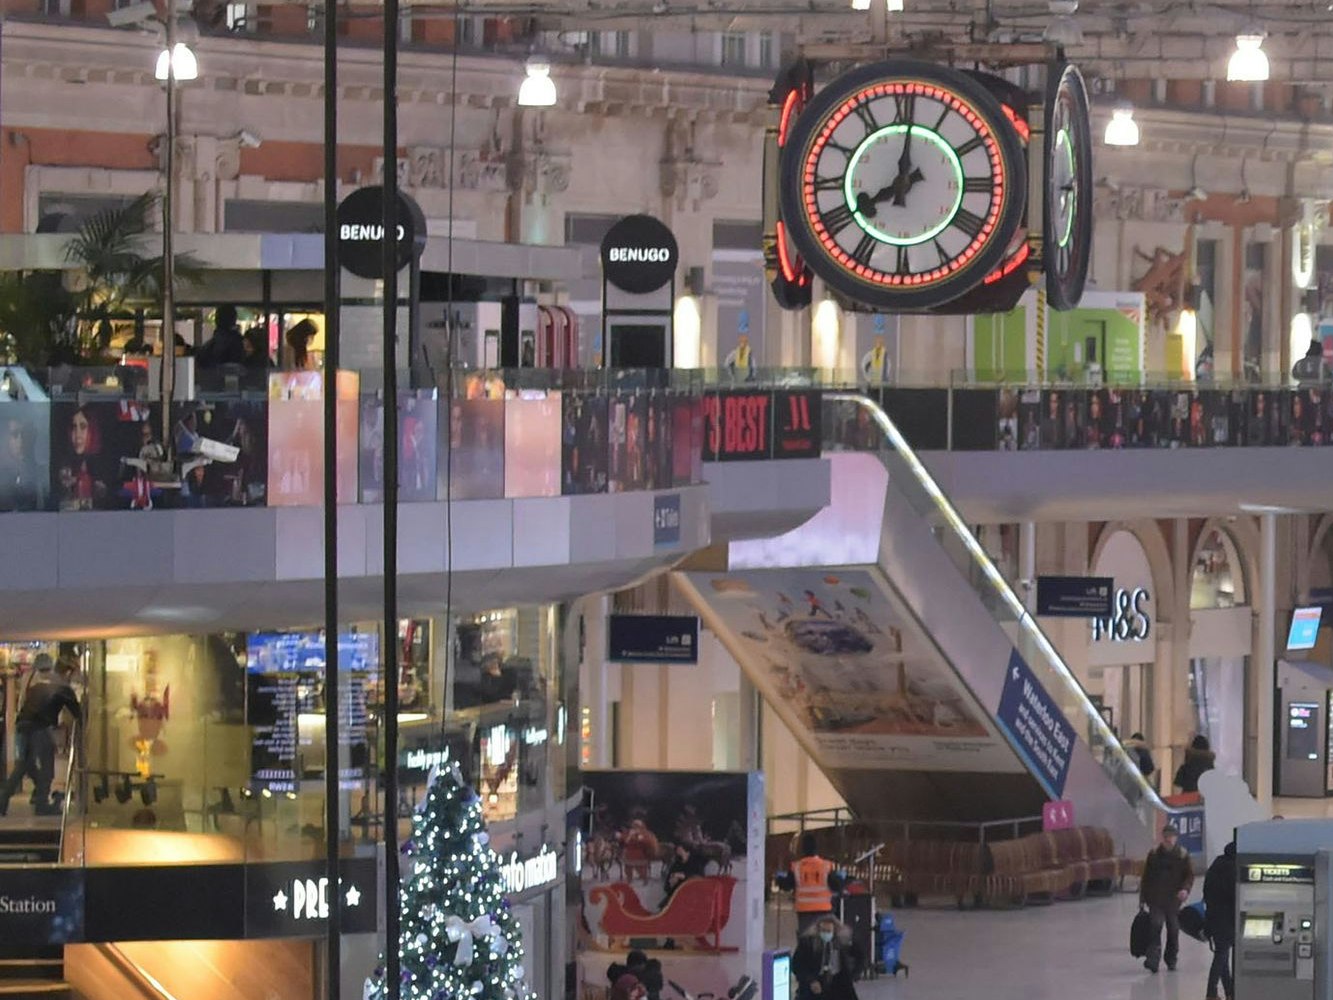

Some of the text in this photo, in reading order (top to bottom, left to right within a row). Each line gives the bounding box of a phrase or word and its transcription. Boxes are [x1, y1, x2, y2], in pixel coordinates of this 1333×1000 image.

[609, 248, 670, 262] BENUGO
[725, 396, 768, 452] BEST
[1023, 677, 1070, 752] Waterloo East
[0, 897, 56, 913] Station
[293, 877, 343, 919] PRE
